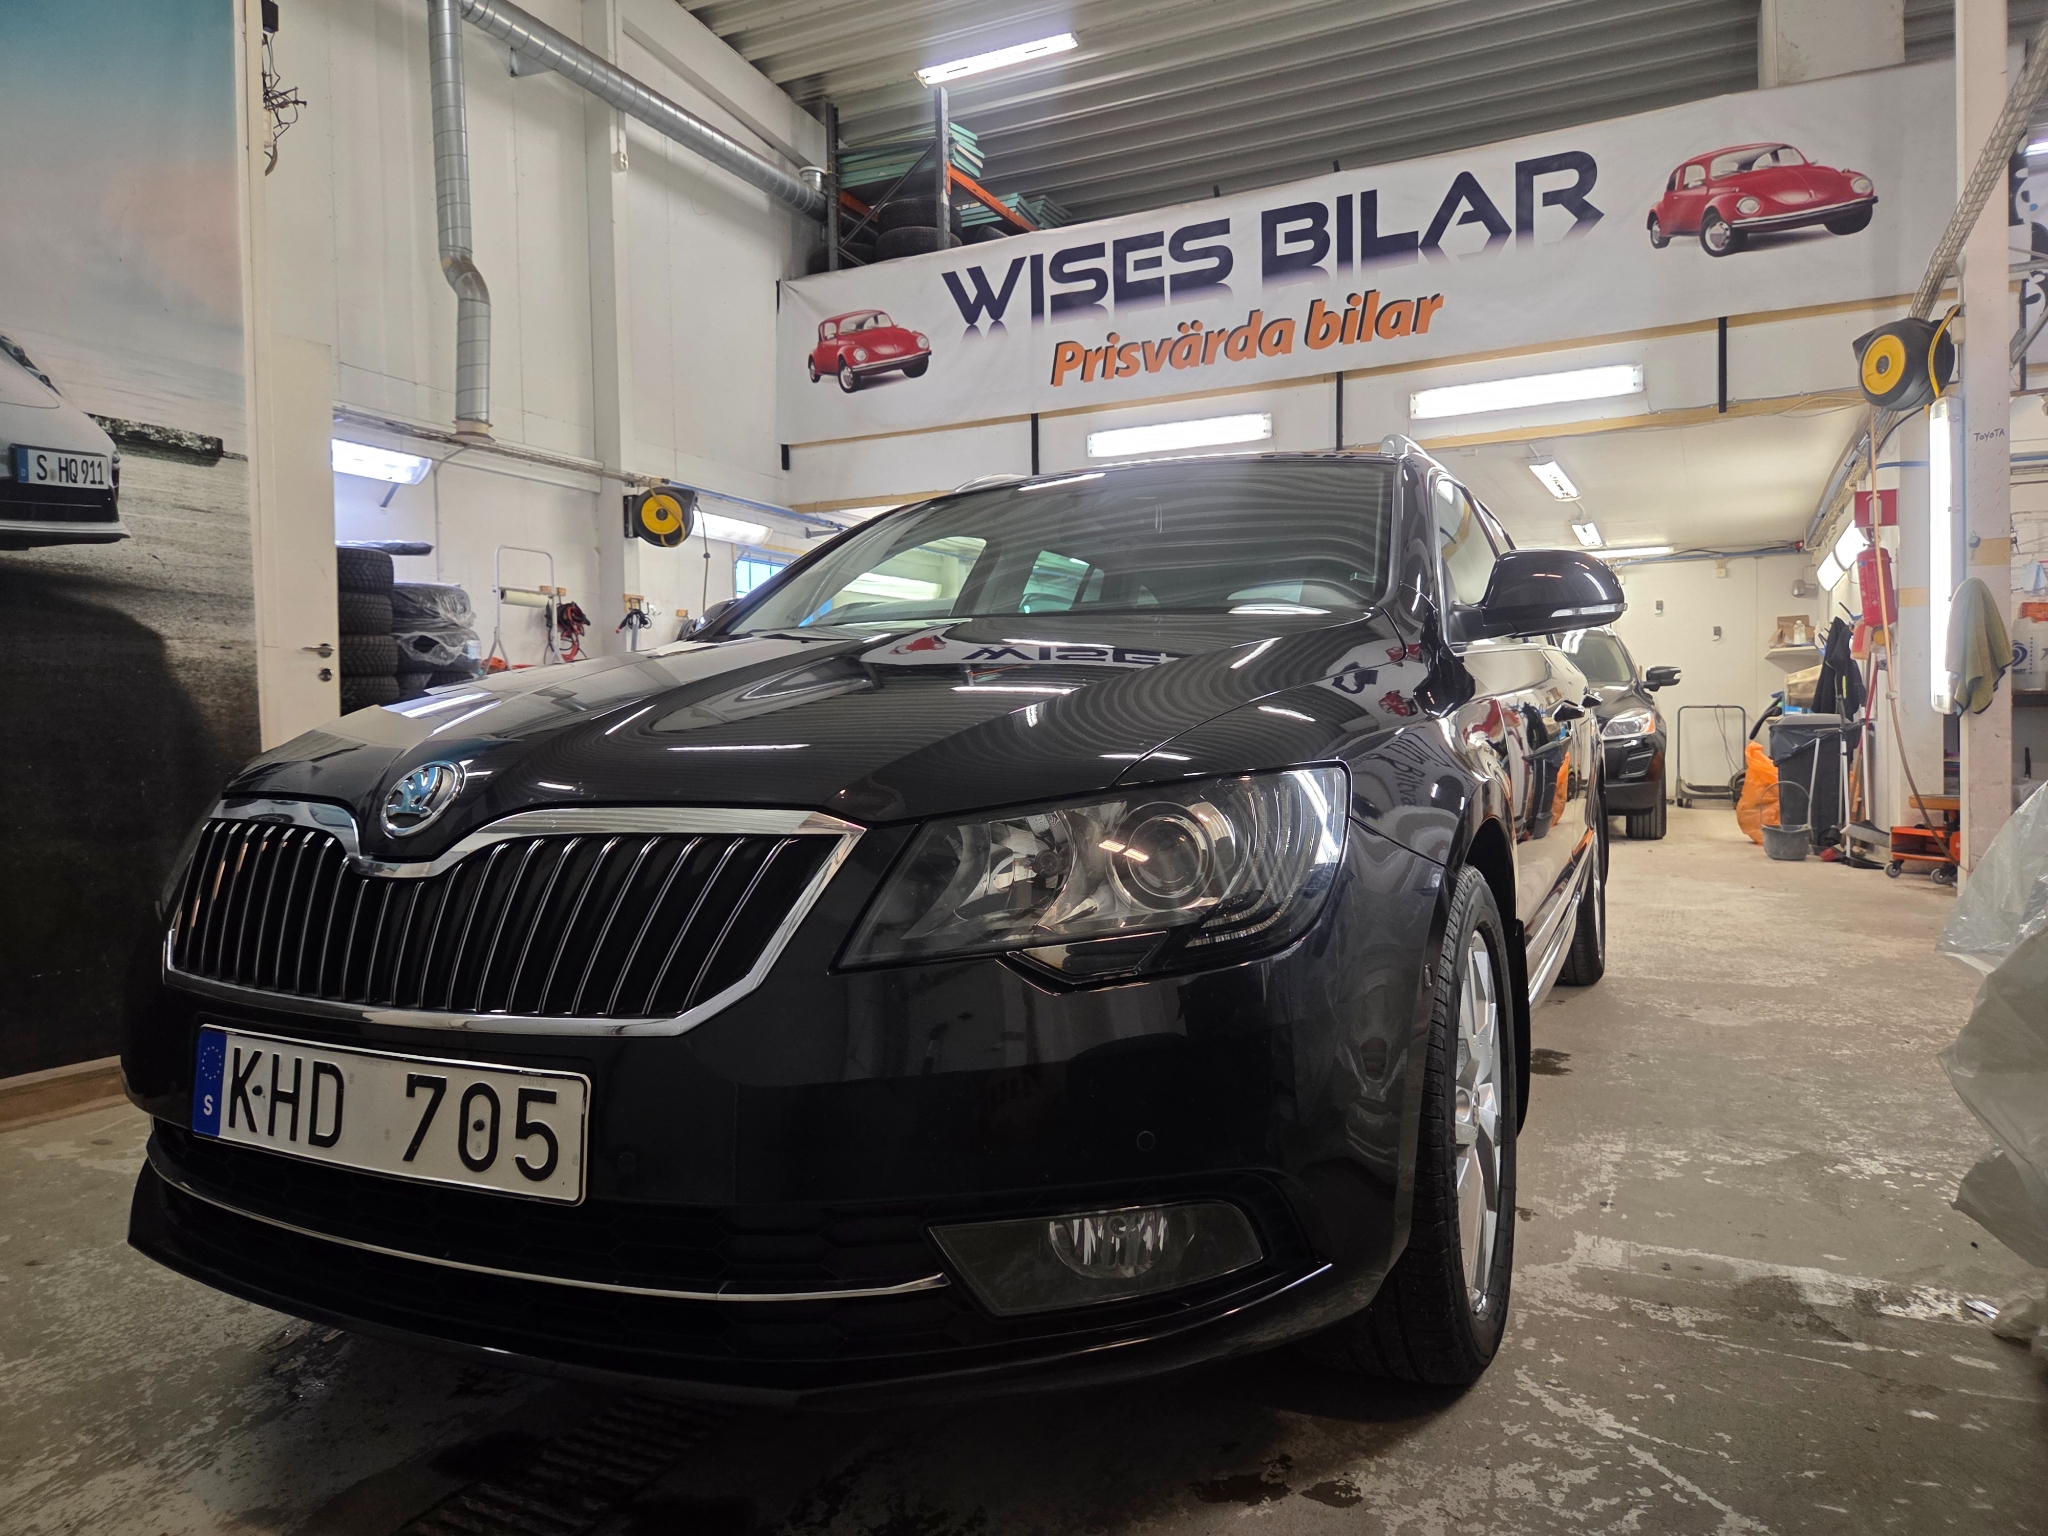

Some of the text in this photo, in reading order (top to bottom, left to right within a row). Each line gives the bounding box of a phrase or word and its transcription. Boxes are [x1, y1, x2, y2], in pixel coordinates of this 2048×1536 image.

[941, 150, 1605, 328] WISES BILAR
[1050, 288, 1445, 388] Prisvärda bilar
[203, 1094, 214, 1116] S
[228, 1046, 560, 1183] KHD 705
